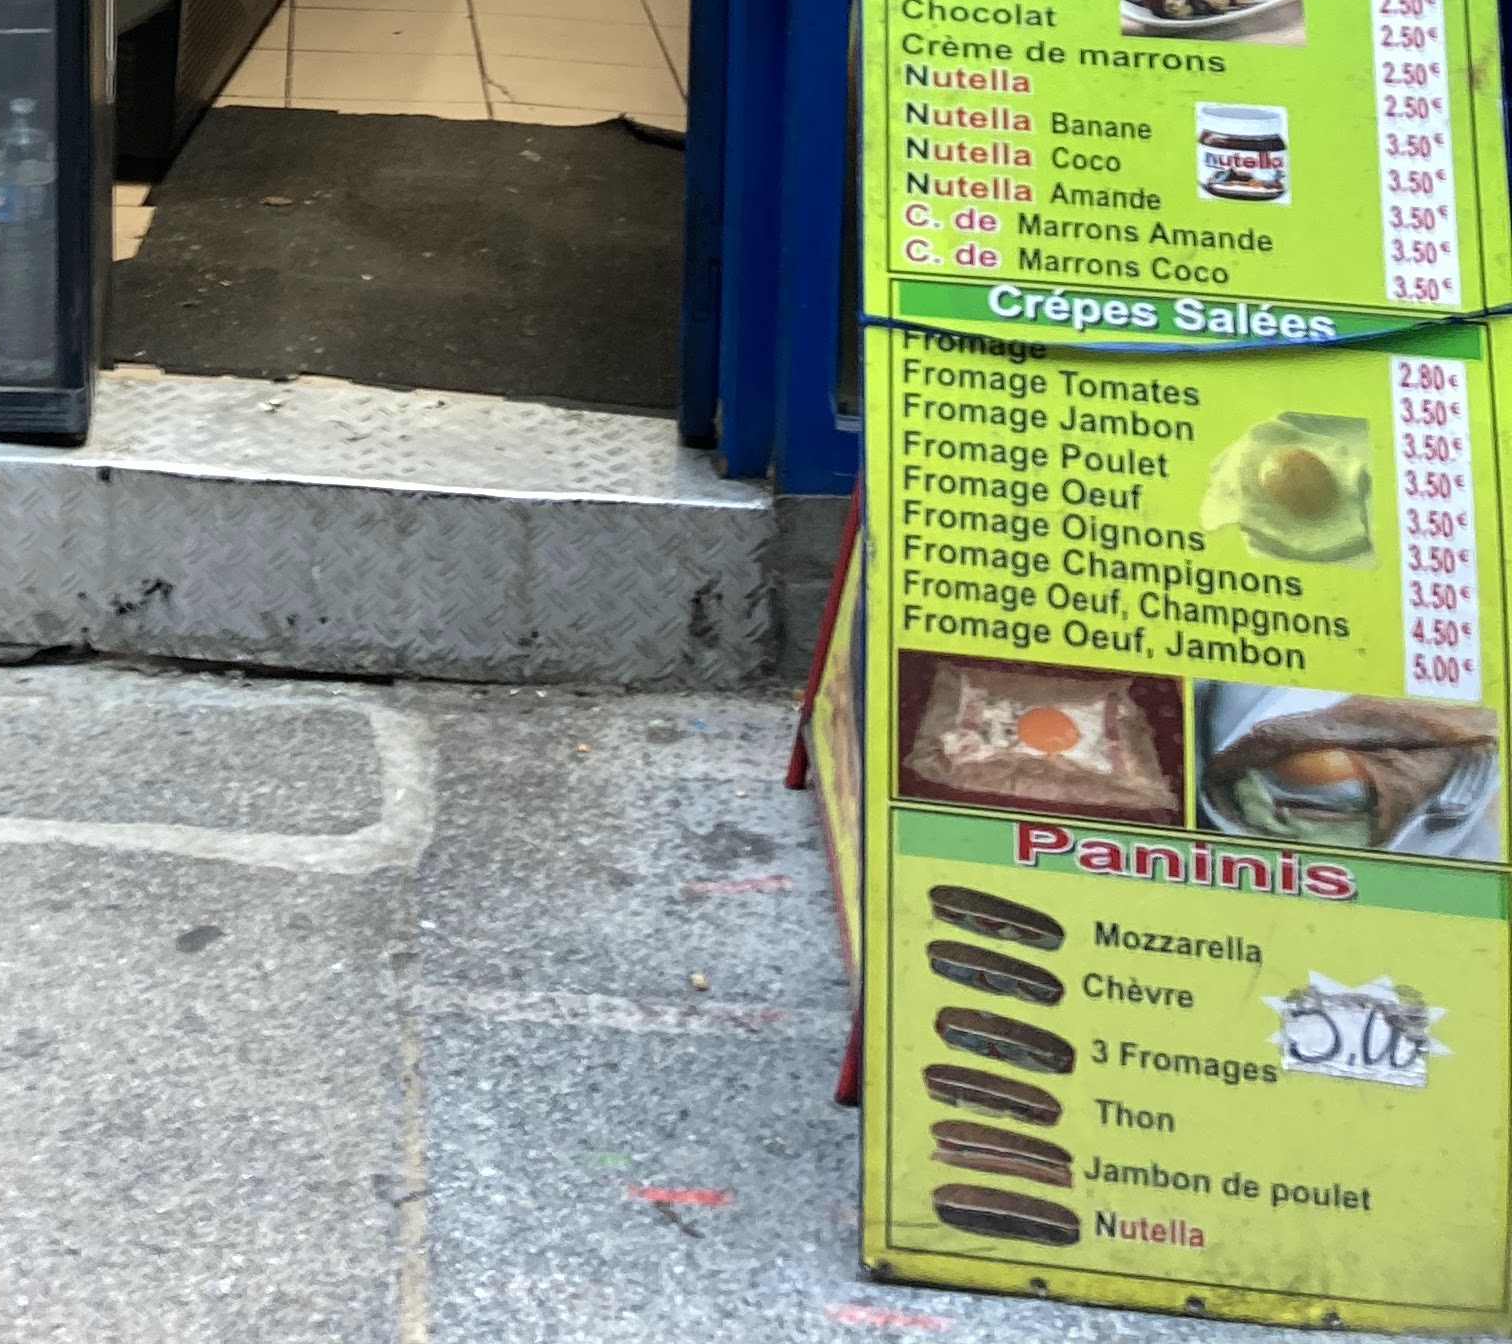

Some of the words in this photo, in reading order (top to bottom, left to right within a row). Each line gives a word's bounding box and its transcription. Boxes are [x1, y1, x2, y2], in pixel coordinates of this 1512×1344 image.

[902, 33, 1012, 62] Crème
[1026, 41, 1066, 64] de
[1079, 48, 1226, 74] marrons
[905, 63, 1032, 94] Nutella
[906, 101, 1033, 133] Nutella
[1051, 113, 1153, 141] Banane
[906, 138, 1033, 169] Nutella
[1051, 148, 1122, 173] Coco
[1205, 151, 1285, 171] nutella
[906, 172, 1034, 203] Nutella
[1050, 184, 1161, 211] Amande
[905, 204, 942, 229] C.
[955, 206, 997, 232] de
[1018, 214, 1140, 244] Marrons
[1148, 223, 1274, 254] Amande
[989, 286, 1159, 333] Crépes
[1173, 299, 1336, 340] Salées
[902, 360, 1048, 397] Fromage
[1059, 371, 1202, 407] Tomates
[902, 395, 1048, 432] Fromage
[1059, 406, 1195, 442] Jambon
[902, 433, 1049, 469] Fromage
[1062, 444, 1169, 478] Poulet
[902, 466, 1049, 504] Fromage
[1062, 478, 1142, 510] Oeuf
[902, 501, 1049, 540] Fromage
[1063, 513, 1206, 556] Oignons
[903, 536, 1050, 576] Fromage
[1063, 548, 1303, 601] Champignons
[903, 571, 1038, 611] Fromage
[1047, 581, 1128, 619] Oeuf,
[1139, 591, 1350, 640] Champgnons
[903, 606, 1051, 648] Fromage
[1063, 619, 1155, 658] Oeuf,
[1165, 631, 1306, 671] Jambon
[1014, 821, 1357, 900] Paninis
[1093, 921, 1262, 964] Mozzarella
[1082, 973, 1195, 1009] Chèvre
[1091, 1039, 1108, 1064] 3
[1120, 1042, 1278, 1087] Fromages
[1095, 1100, 1175, 1132] Thon
[1084, 1158, 1211, 1196] Jambon
[1221, 1172, 1259, 1199] de
[1271, 1181, 1372, 1213] poulet
[1094, 1212, 1205, 1248] Nutella
